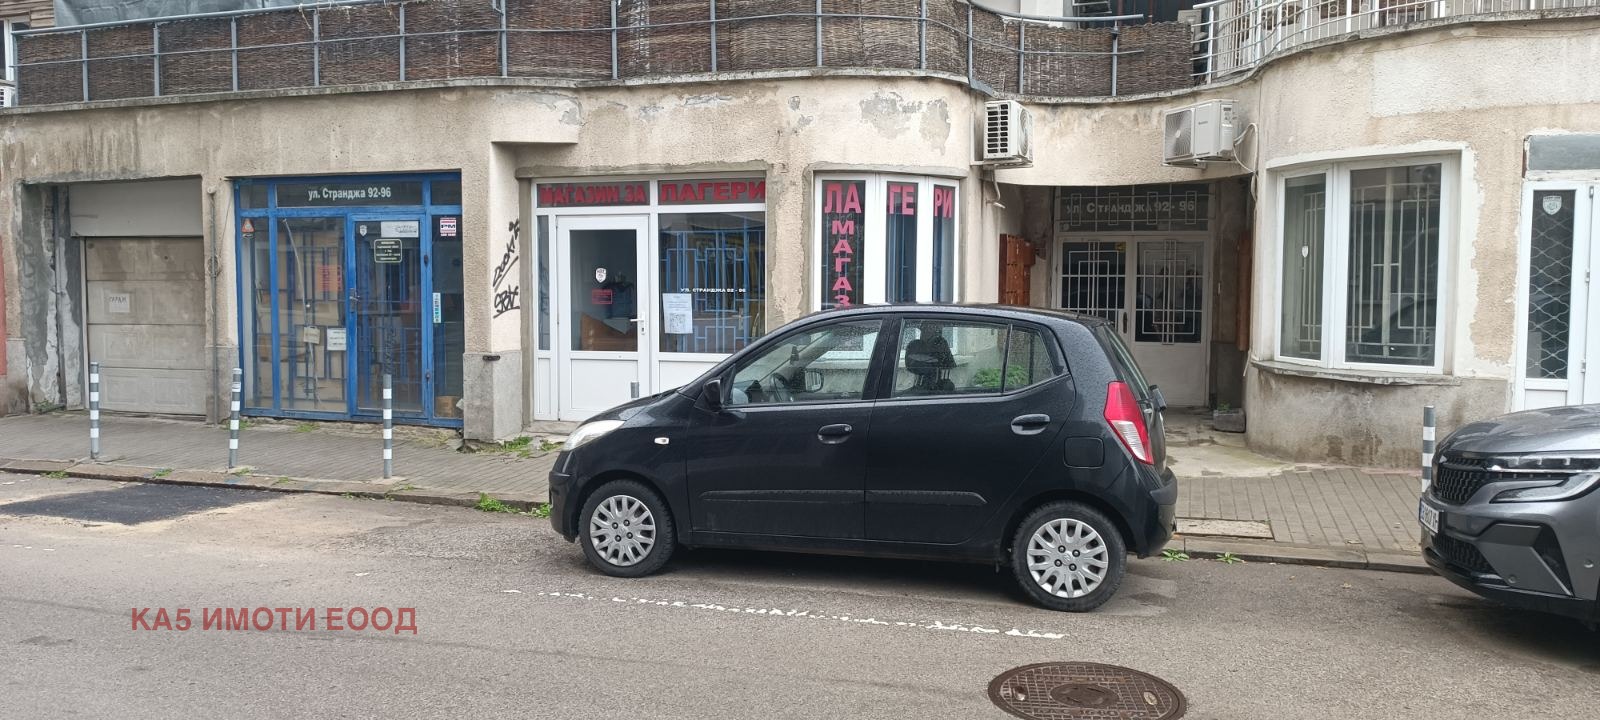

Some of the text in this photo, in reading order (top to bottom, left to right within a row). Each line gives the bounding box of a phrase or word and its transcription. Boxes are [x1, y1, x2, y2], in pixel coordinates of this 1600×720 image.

[308, 186, 392, 202] ул. Странджа 92-96
[540, 183, 620, 206] МАГАЗИН
[624, 183, 648, 204] ЗА
